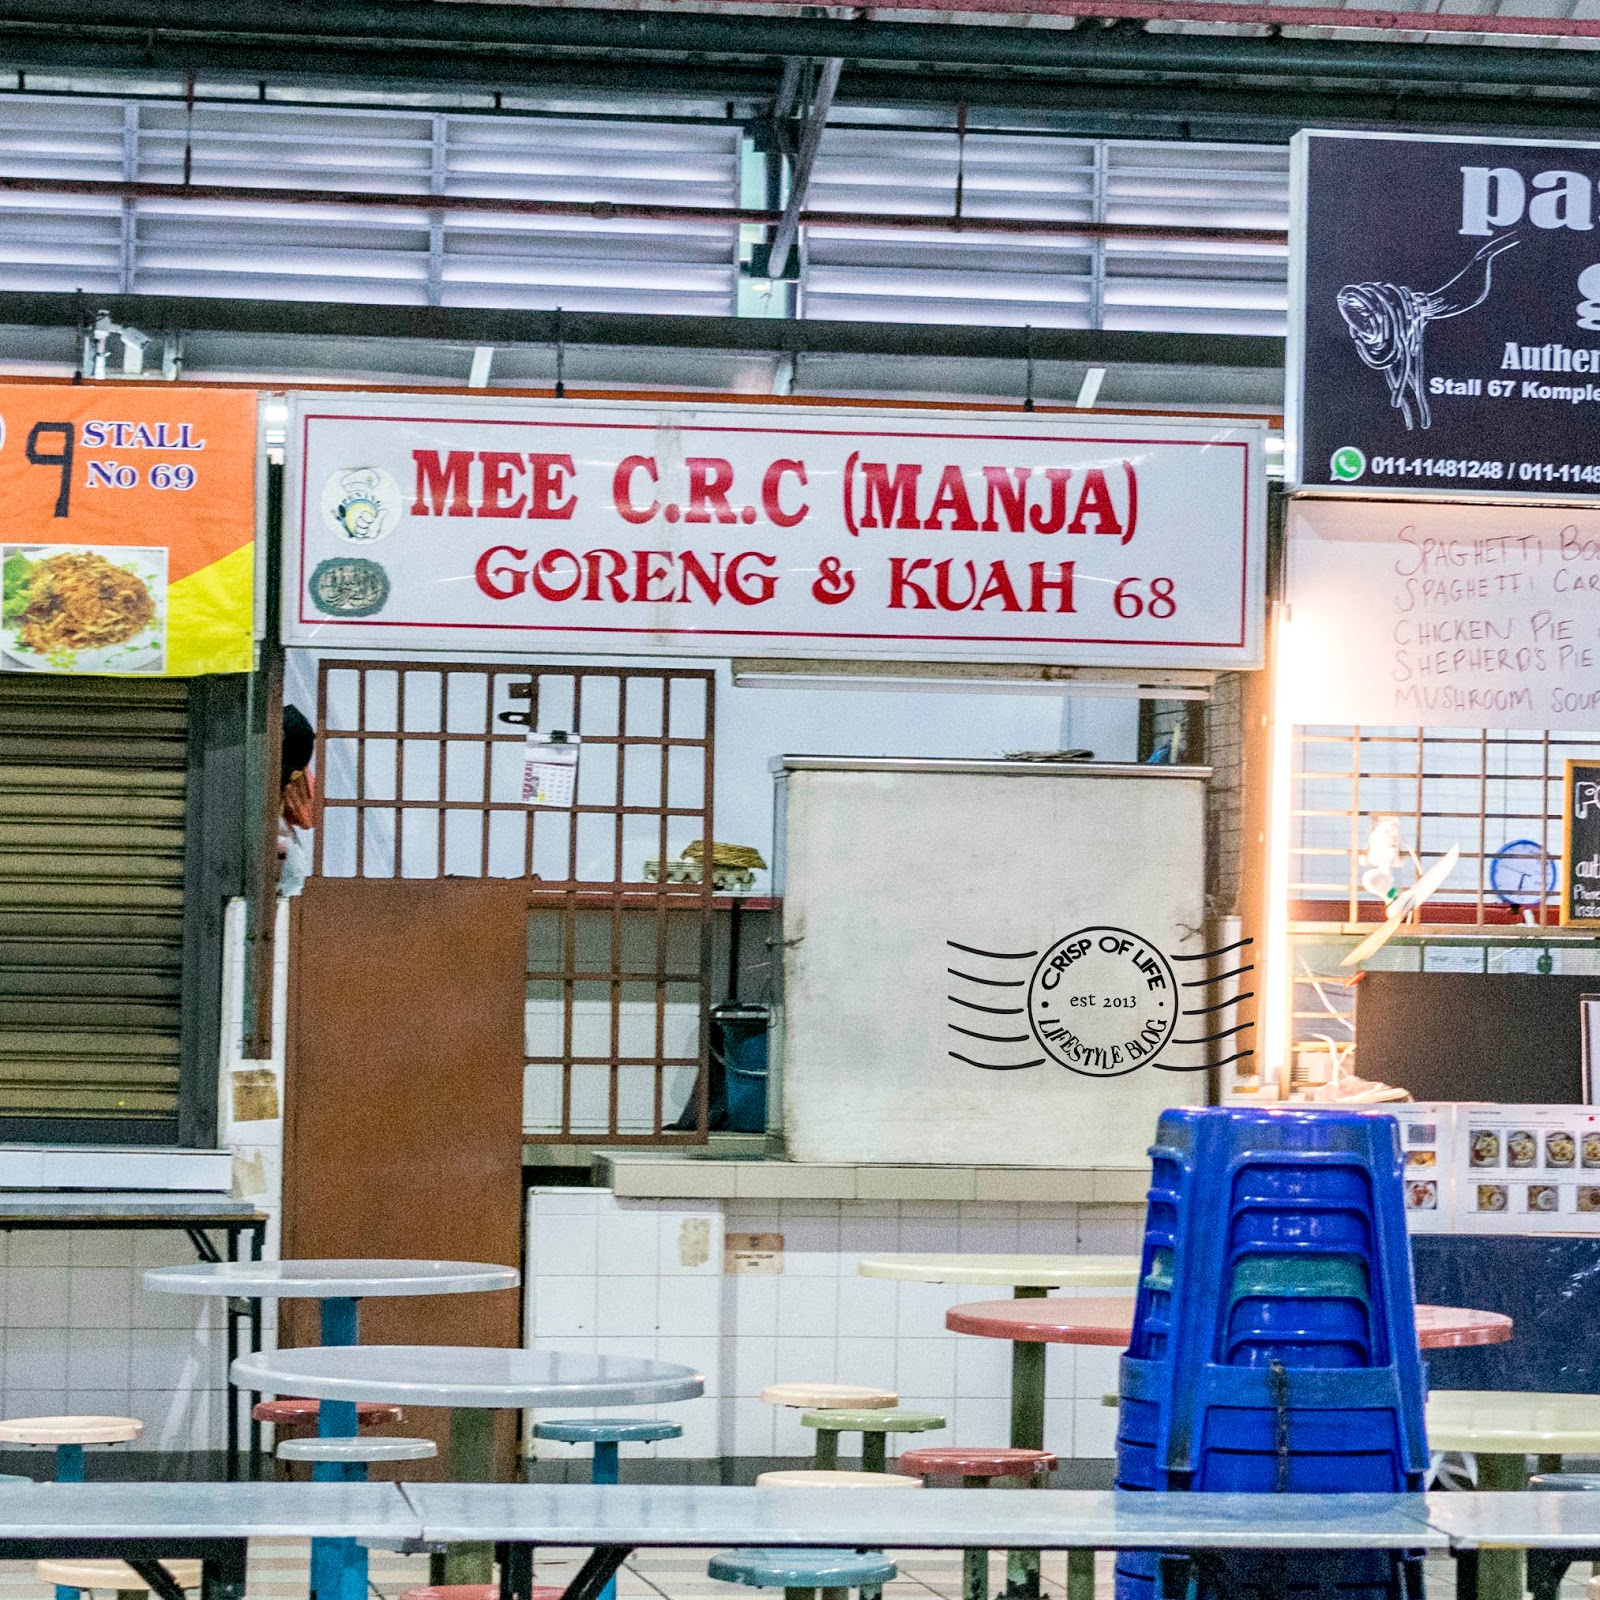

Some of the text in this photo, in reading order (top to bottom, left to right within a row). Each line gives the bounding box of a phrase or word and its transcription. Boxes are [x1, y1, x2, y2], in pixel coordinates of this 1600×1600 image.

[1458, 166, 1600, 236] pa
[1429, 377, 1481, 397] Stall
[1487, 380, 1516, 397] 67
[81, 420, 205, 450] STALL
[149, 465, 197, 490] 69
[1370, 456, 1503, 480] 011-11481248
[411, 449, 1137, 544] MEE C.R.C (MANJA)
[1395, 525, 1543, 576] SPAGHETTI
[474, 544, 1177, 619] GORENG & KUAH 68
[1394, 572, 1534, 613] SPAGHETTI
[1393, 609, 1575, 646] CHICKEN PIE
[1559, 645, 1592, 673] PIE
[1394, 684, 1534, 714] MUSHROOM
